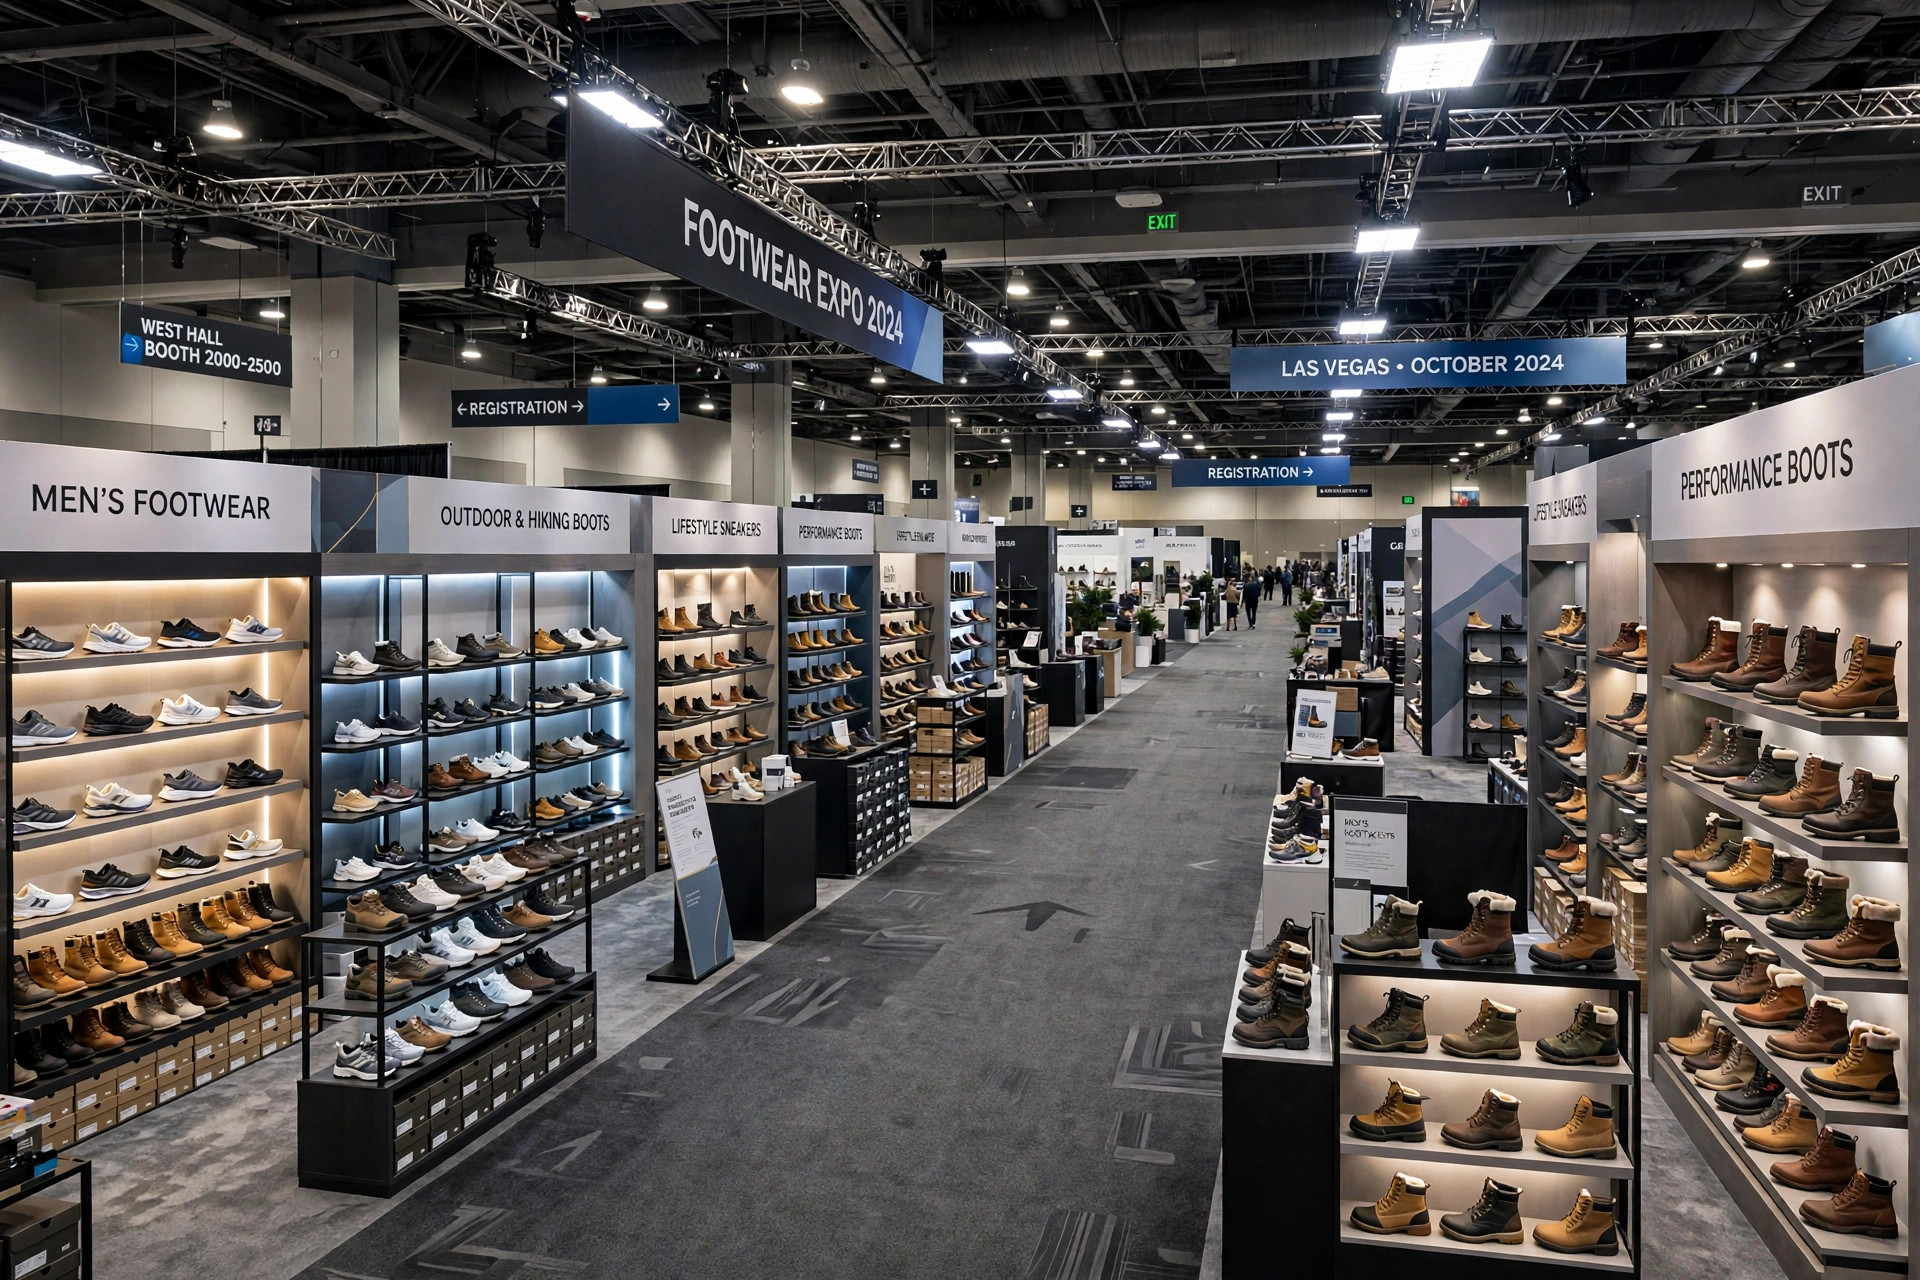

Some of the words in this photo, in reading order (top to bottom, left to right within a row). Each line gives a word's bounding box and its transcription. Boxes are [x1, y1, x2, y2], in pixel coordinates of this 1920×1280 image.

[1803, 185, 1842, 201] EXIT
[1148, 214, 1176, 230] EXIT
[684, 197, 812, 304] FOOTWEAR
[817, 268, 864, 326] EXPO
[867, 295, 904, 345] 2024
[141, 317, 183, 341] WEST
[186, 325, 223, 347] HALL
[145, 340, 200, 364] BOOTH
[204, 350, 282, 376] 2000-2500
[1281, 360, 1319, 377] LAS
[1324, 358, 1390, 376] VEGAS
[1411, 356, 1507, 374] OCTOBER
[1513, 354, 1565, 372] 2024
[469, 400, 567, 416] REGISTRATION
[1208, 467, 1299, 479] REGISTRATION
[1681, 453, 1782, 501] PERFORMANCE
[1787, 438, 1854, 485] BOOTS
[134, 489, 271, 521] FOOTWEAR
[441, 505, 512, 528] OUTDOOR
[515, 509, 525, 528] &
[528, 510, 570, 531] HIKING
[572, 512, 610, 532] BOOTS
[671, 517, 718, 536] LIFESTYLE
[720, 519, 762, 538] SNEAKERS
[798, 525, 843, 540] PERFORMANCE
[844, 527, 863, 541] BOOTS
